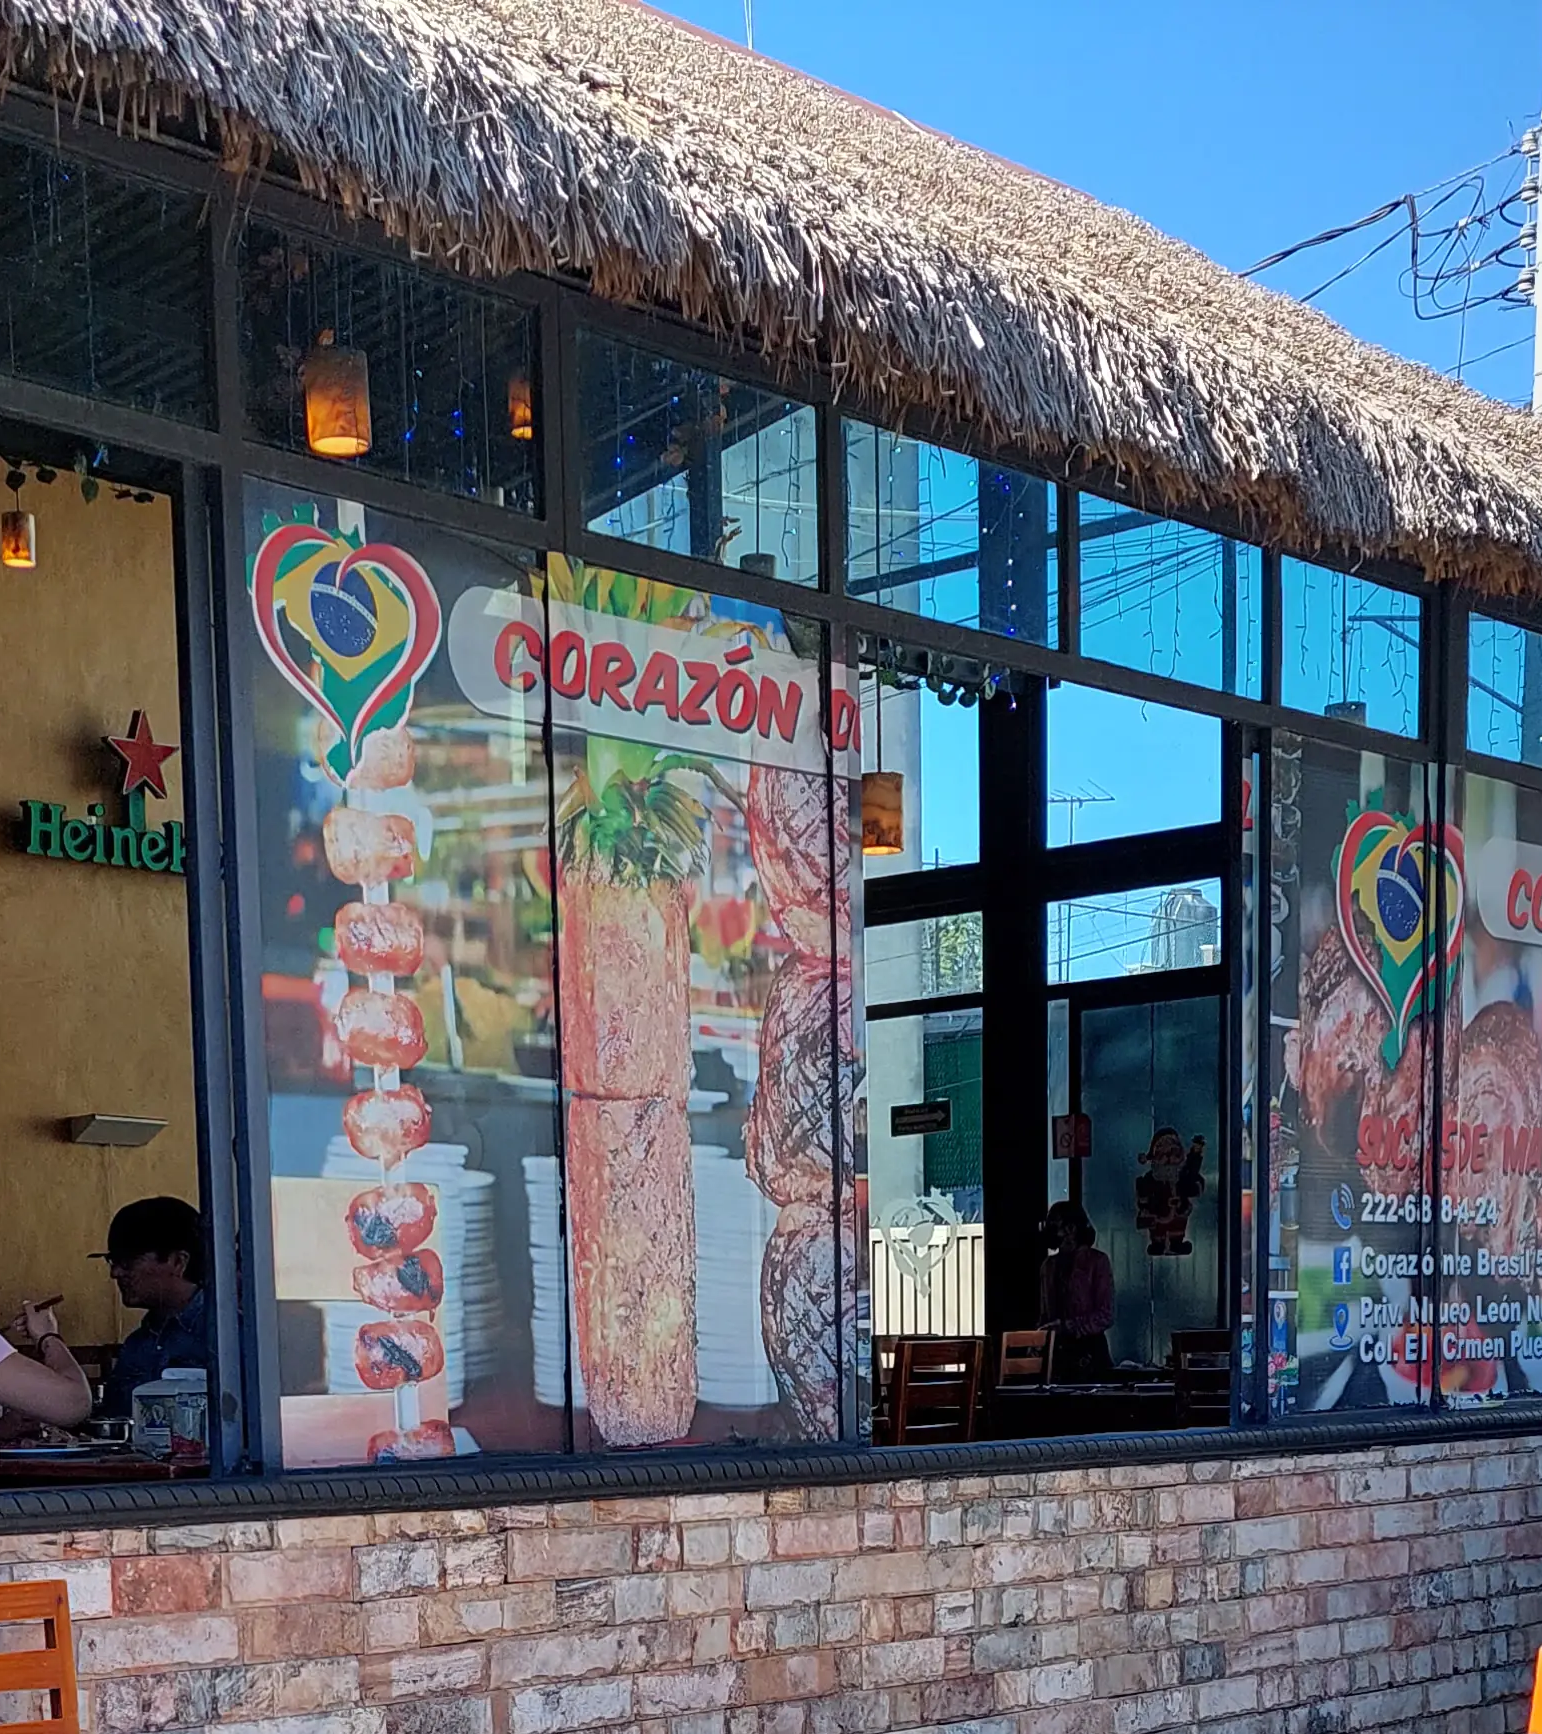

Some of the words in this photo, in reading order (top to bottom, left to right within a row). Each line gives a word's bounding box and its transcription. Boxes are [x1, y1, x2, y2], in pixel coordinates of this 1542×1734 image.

[493, 620, 804, 744] CORAZÓN
[1476, 1294, 1522, 1324] León
[1359, 1333, 1399, 1364] Col.
